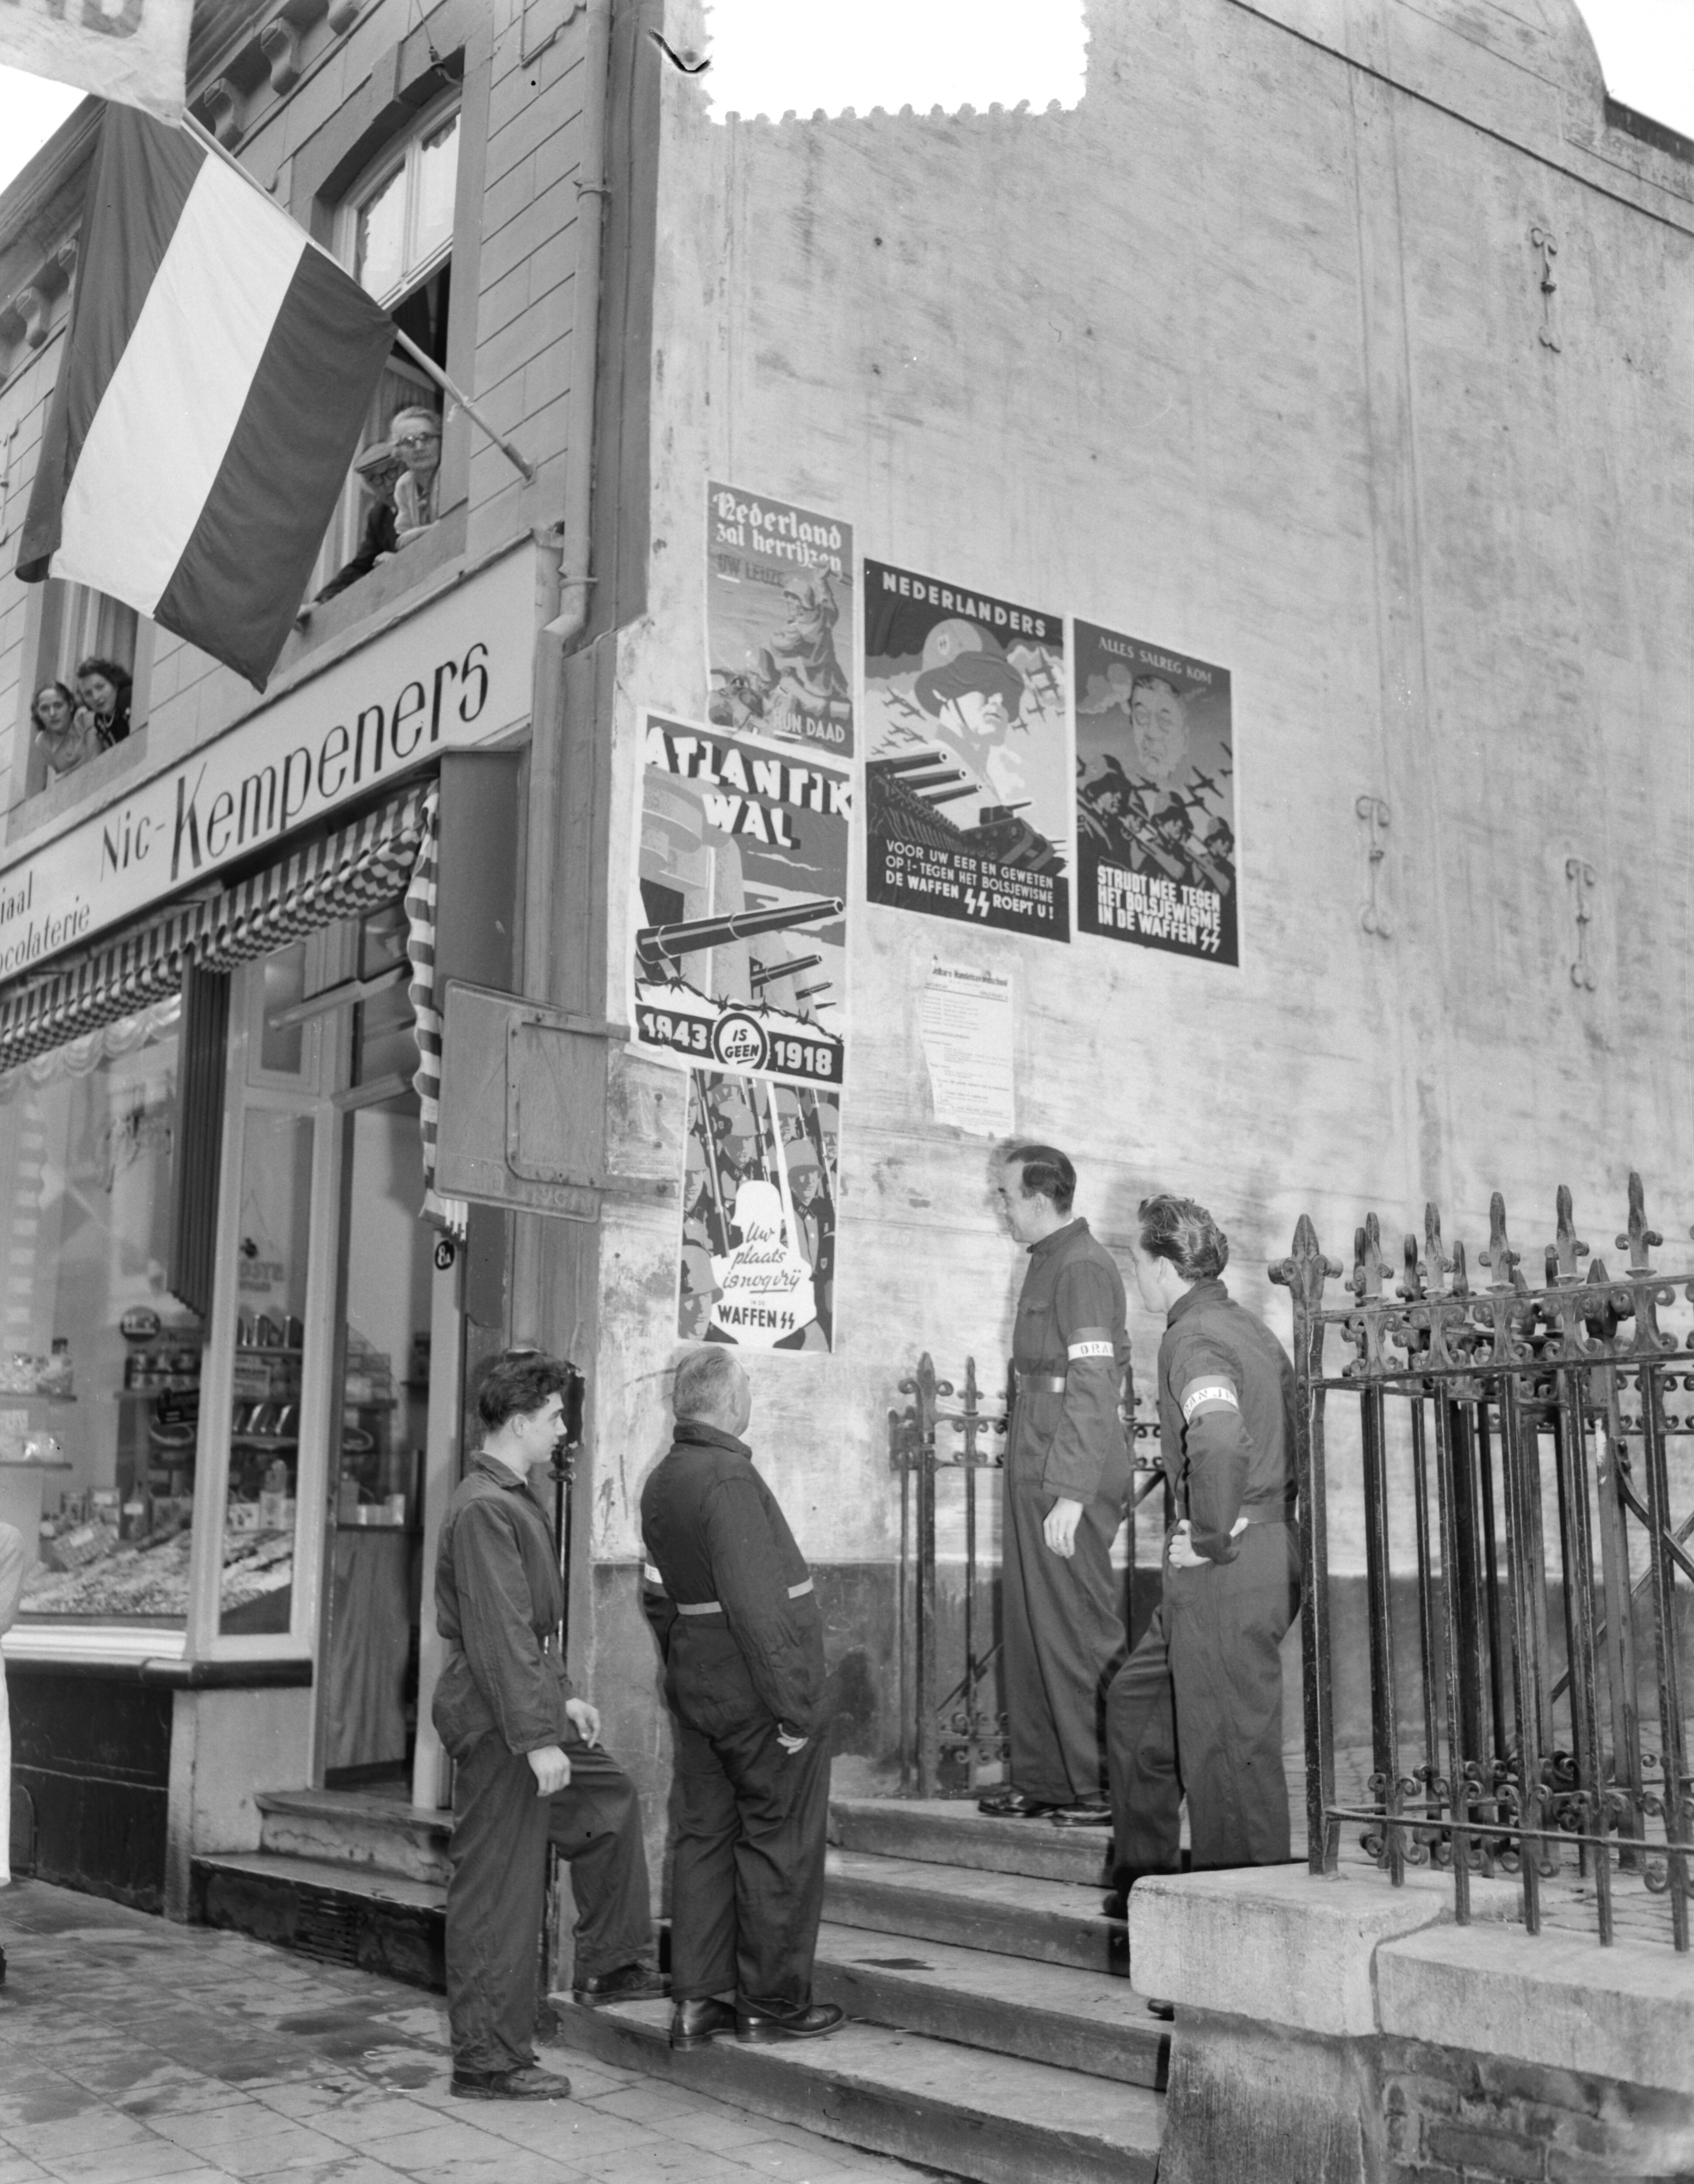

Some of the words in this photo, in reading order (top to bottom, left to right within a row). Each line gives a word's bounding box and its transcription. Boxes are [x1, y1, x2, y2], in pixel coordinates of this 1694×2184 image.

[712, 491, 841, 550] Nederland
[716, 523, 745, 546] zal
[752, 529, 842, 577] herrijzen
[882, 571, 1046, 637] NEDERLANDERS
[1099, 636, 1134, 658] ALLES
[1186, 665, 1212, 685] KOM
[806, 716, 845, 743] DAAD
[645, 726, 852, 821] ATLANTIK
[702, 794, 793, 848] WAL
[886, 839, 924, 859] VOOR
[929, 850, 948, 864] UW
[954, 855, 976, 871] EER
[981, 862, 996, 875] EN
[1001, 867, 1053, 888] GEWETEN
[920, 862, 954, 881] TEGEN
[959, 871, 977, 886] HET
[982, 877, 1053, 902] BOLSJEWISME
[885, 870, 903, 886] DE
[907, 875, 959, 898] WAFFEN
[993, 895, 1034, 915] ROEPT
[1098, 884, 1122, 908] HET
[1126, 890, 1221, 932] BOLSJEWISME
[1149, 877, 1177, 902] MEE
[1180, 885, 1220, 912] TEGEN
[1098, 904, 1113, 926] IN
[1117, 909, 1135, 930] DE
[1137, 913, 1197, 945] WAFFEN
[642, 1013, 707, 1050] 1943
[725, 1044, 759, 1058] GEEN
[733, 1029, 747, 1042] IS
[774, 1041, 832, 1076] 1918
[746, 1222, 775, 1243] Uw
[438, 1245, 451, 1266] 8A
[731, 1245, 787, 1270] plaats
[718, 1304, 777, 1328] WAFFEN
